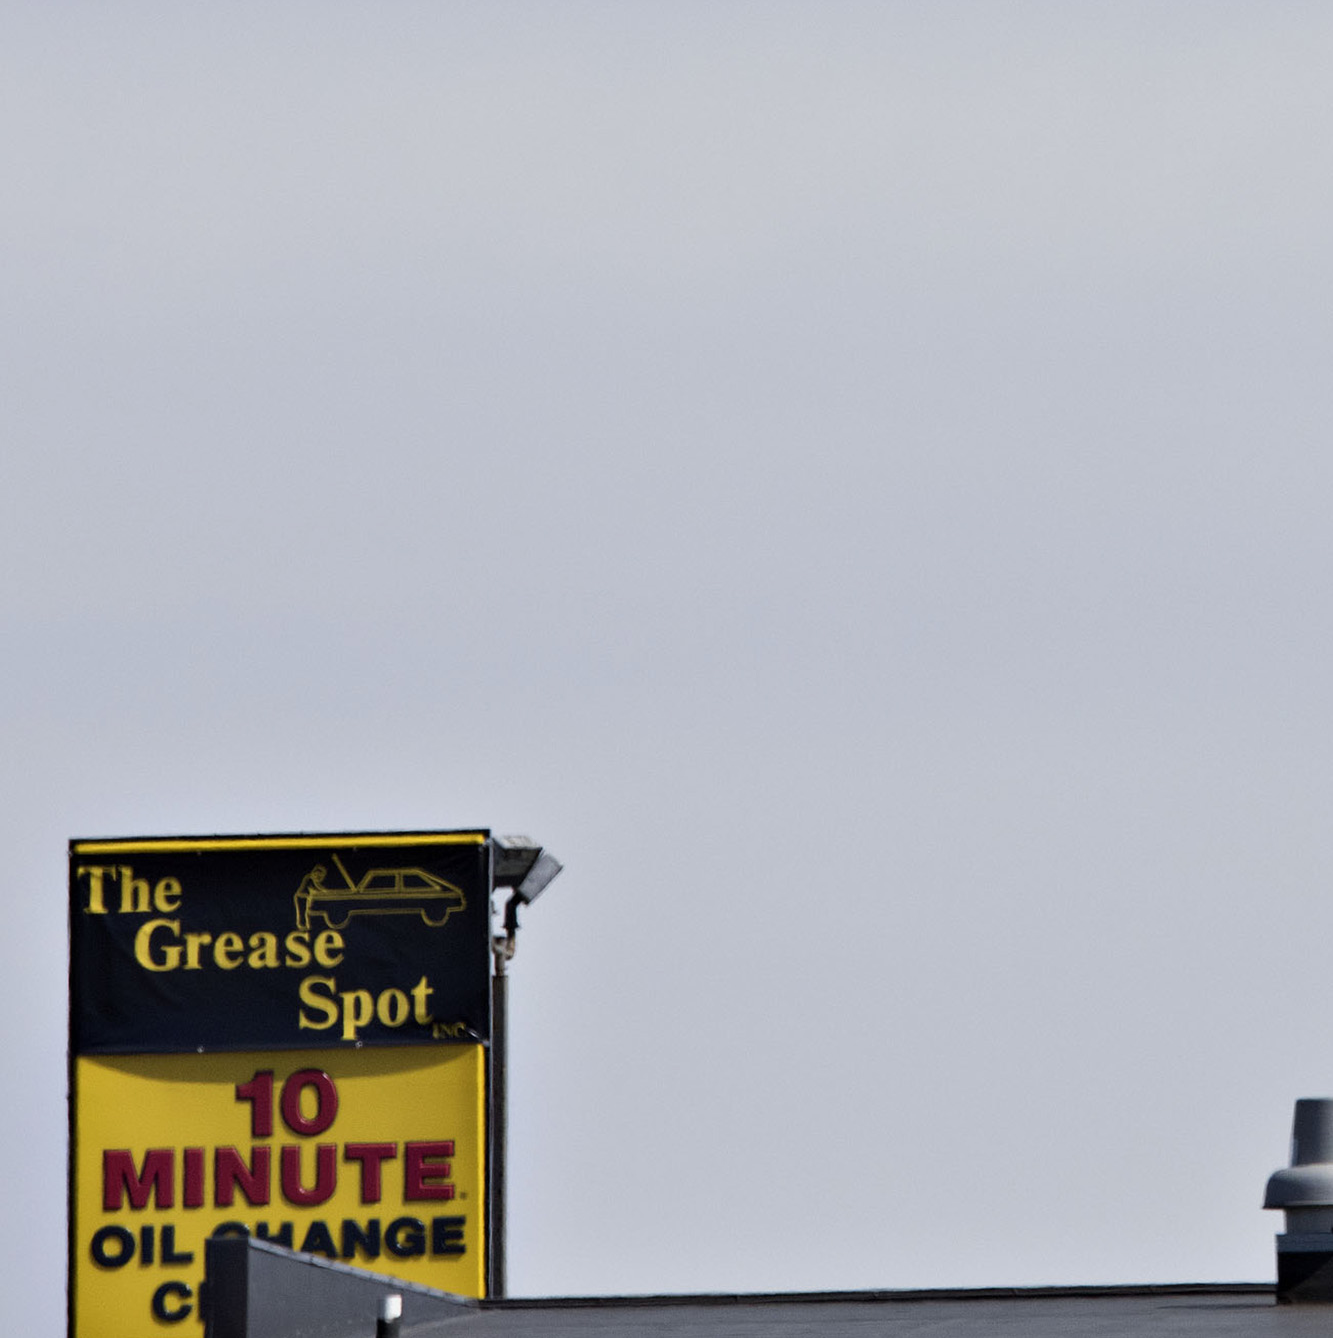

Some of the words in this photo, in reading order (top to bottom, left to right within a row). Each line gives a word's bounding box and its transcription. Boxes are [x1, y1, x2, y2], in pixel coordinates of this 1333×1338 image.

[77, 865, 183, 915] The
[134, 918, 345, 972] Grease
[298, 975, 434, 1040] Spot
[234, 1069, 338, 1138] 10
[102, 1141, 456, 1211] MINUTE
[90, 1224, 194, 1268] OIL
